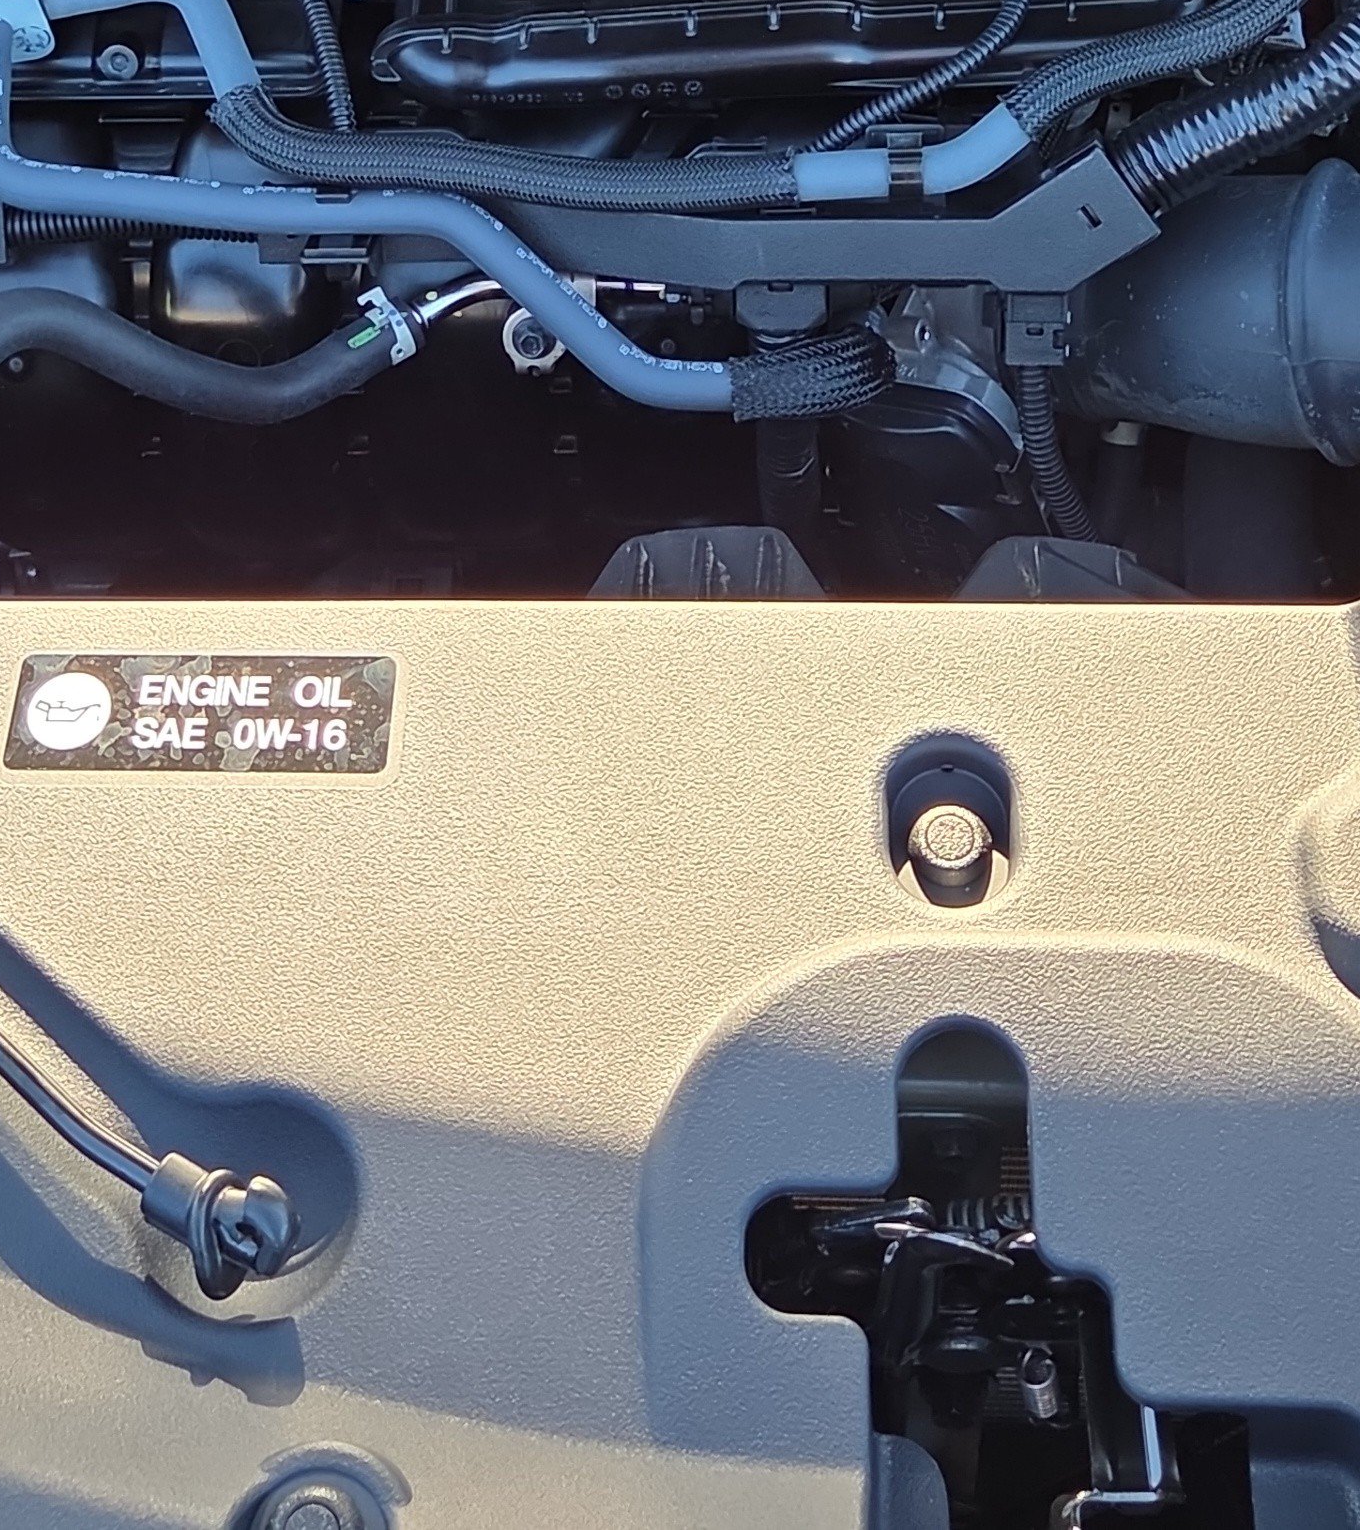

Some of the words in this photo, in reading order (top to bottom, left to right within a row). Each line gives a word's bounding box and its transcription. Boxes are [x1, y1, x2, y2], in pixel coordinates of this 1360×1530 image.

[138, 674, 273, 708] ENGINE
[293, 675, 353, 709] OIL
[131, 716, 209, 750] SAE
[232, 717, 348, 752] 0W-16
